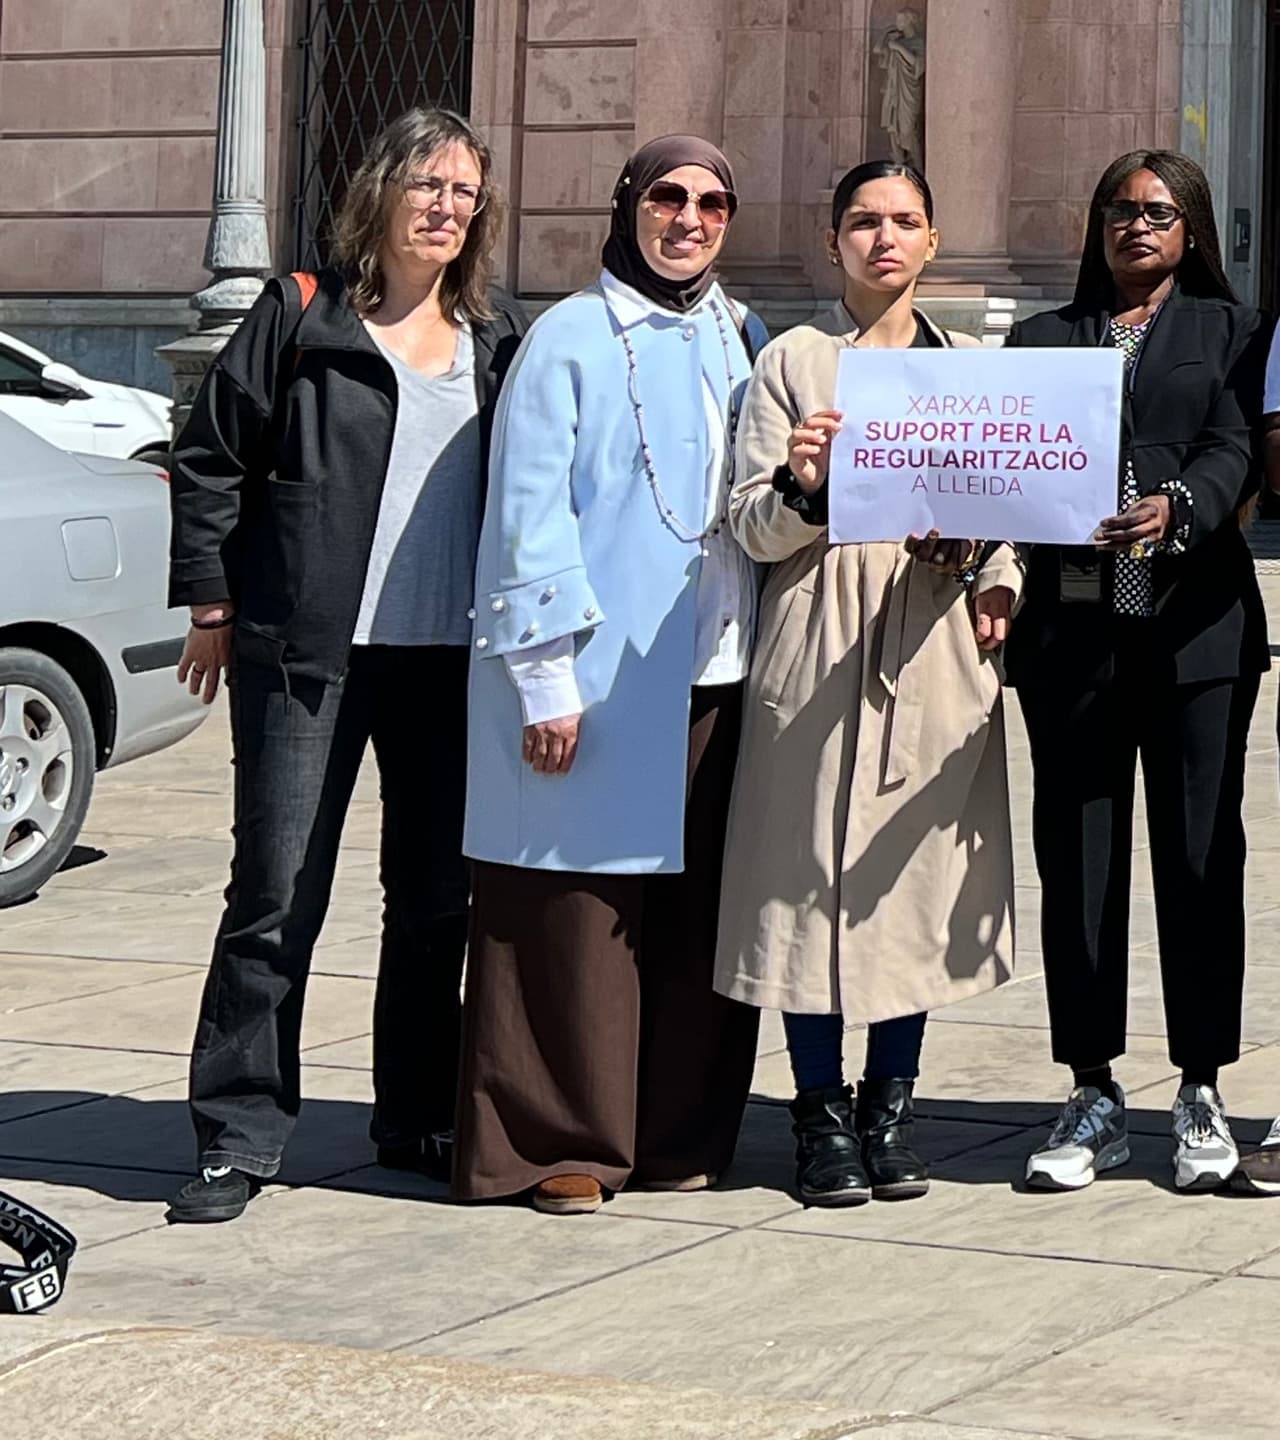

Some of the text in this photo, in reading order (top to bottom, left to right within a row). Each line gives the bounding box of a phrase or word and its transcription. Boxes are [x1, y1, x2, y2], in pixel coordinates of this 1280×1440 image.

[906, 395, 1035, 416] XARXA DE
[865, 421, 1073, 443] SUPORT PER LA
[853, 445, 1088, 471] REGULARITZACIÓ
[911, 474, 1024, 496] A LLEIDA
